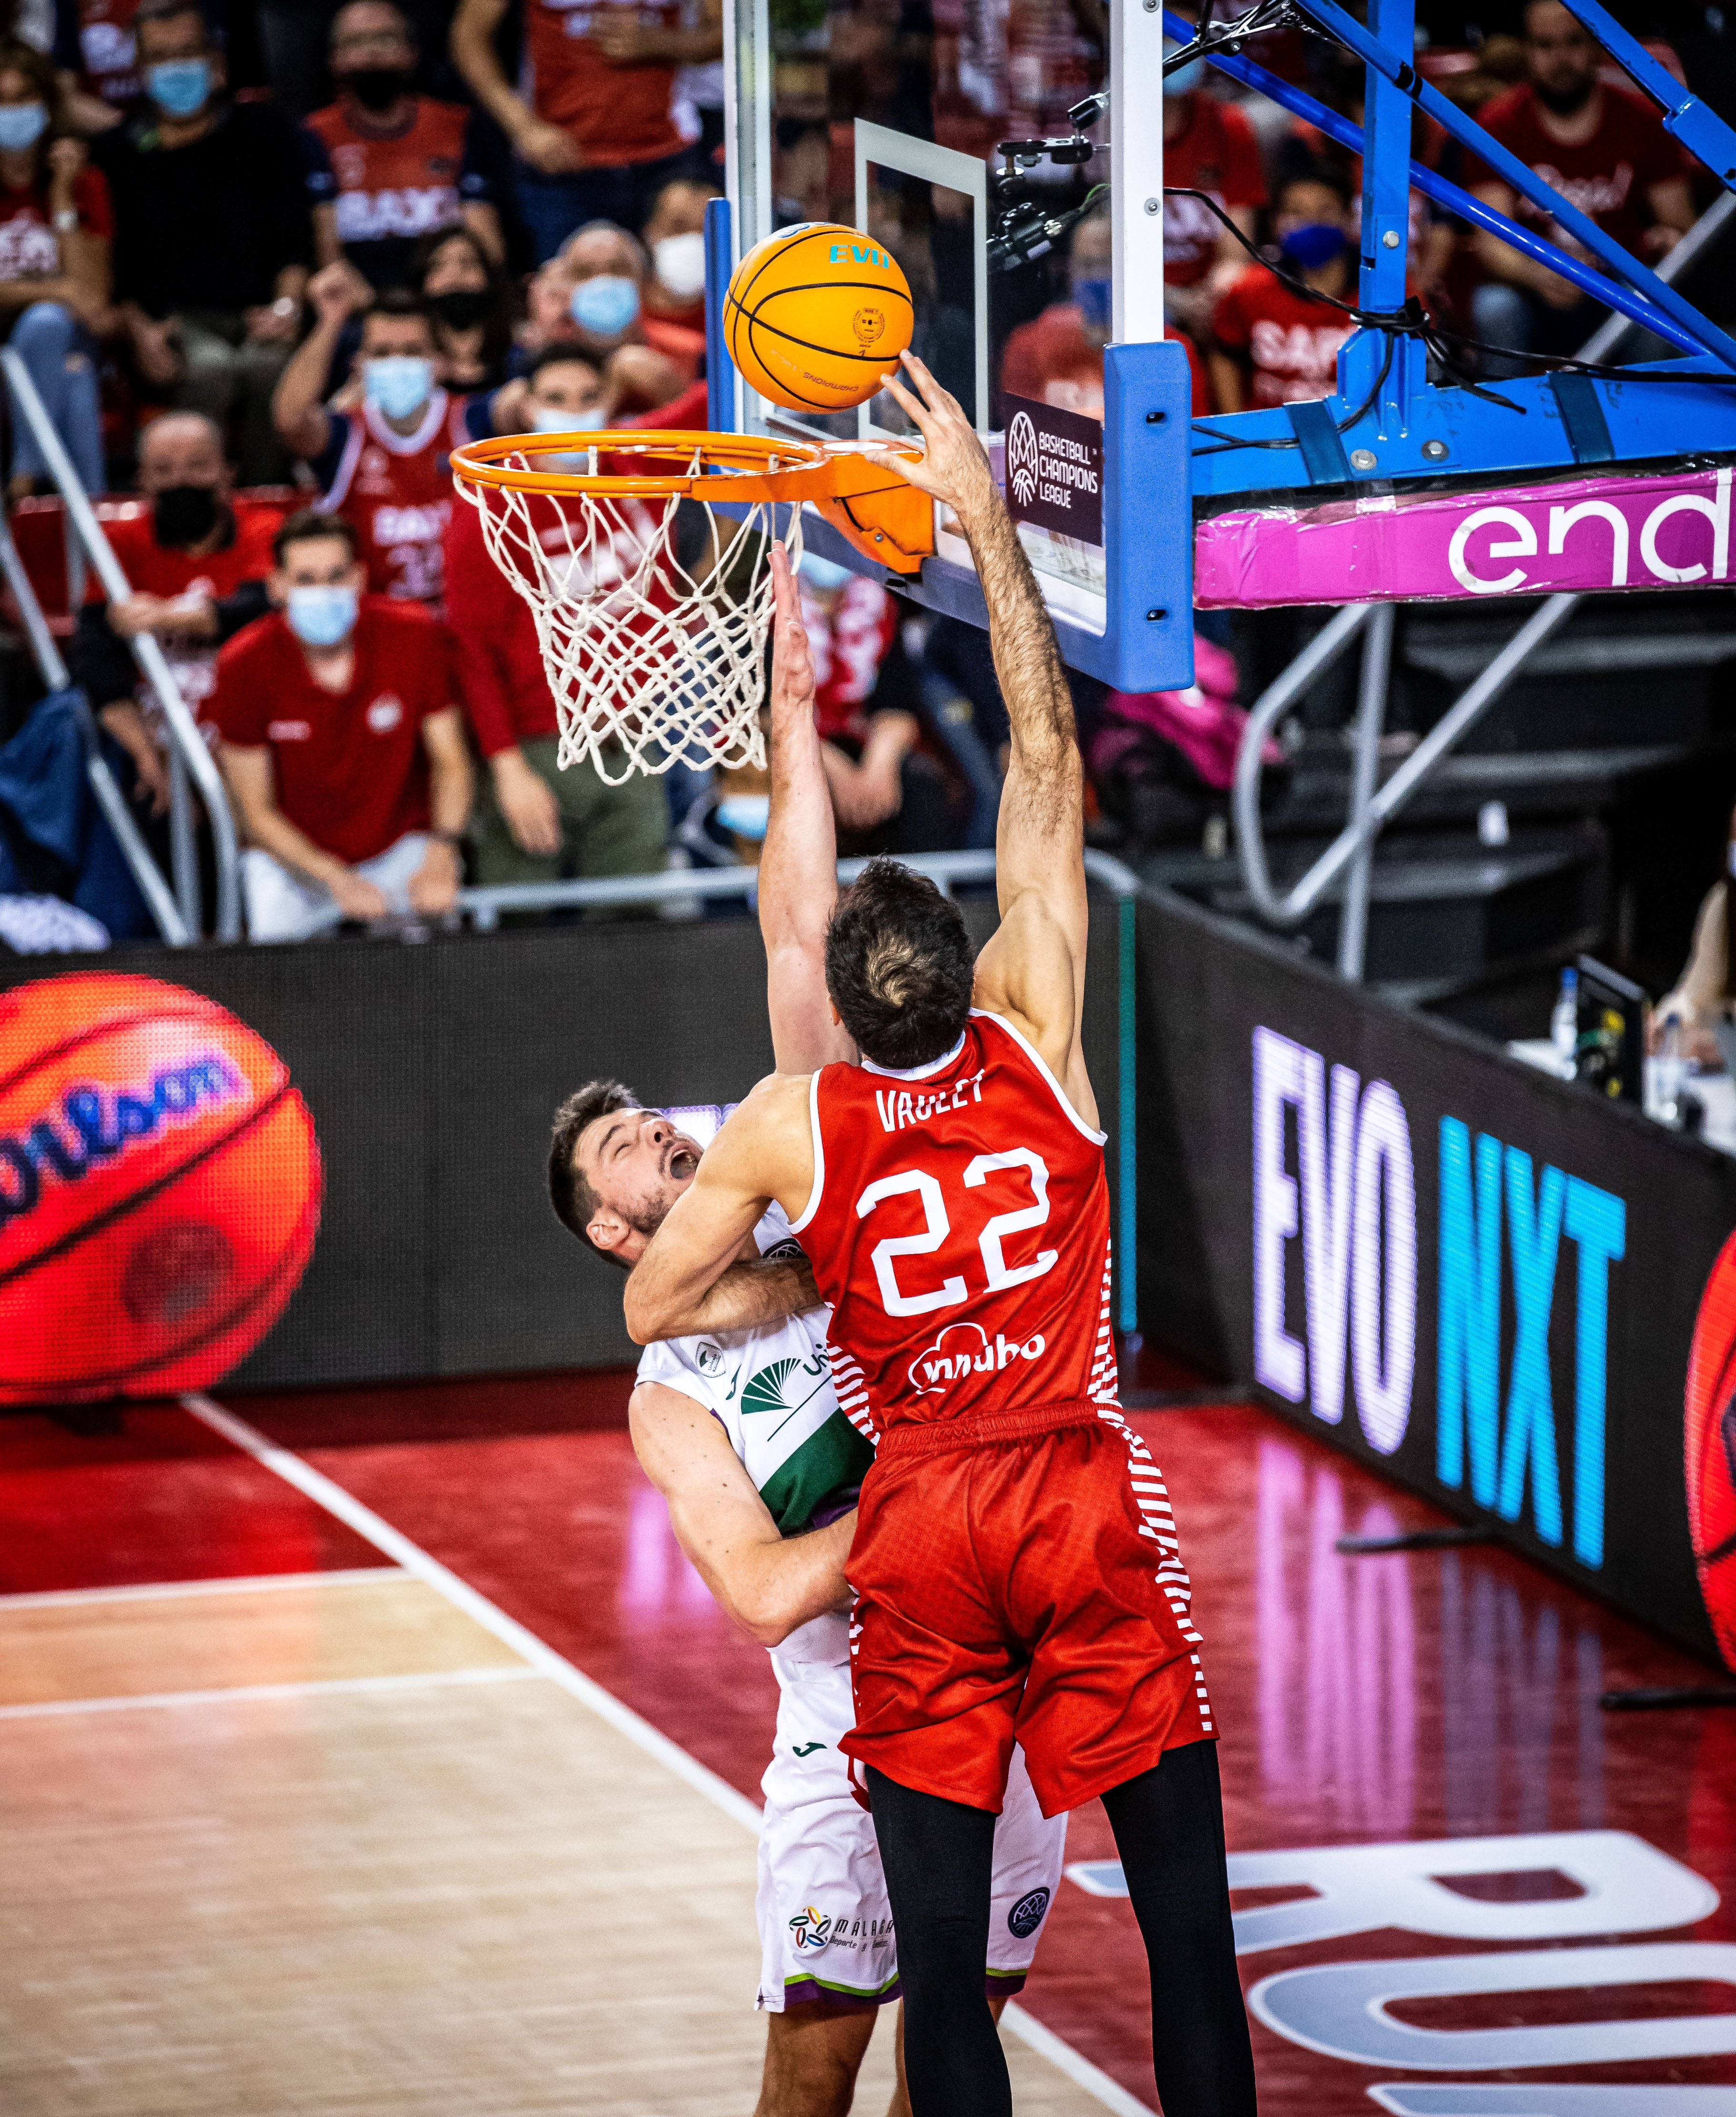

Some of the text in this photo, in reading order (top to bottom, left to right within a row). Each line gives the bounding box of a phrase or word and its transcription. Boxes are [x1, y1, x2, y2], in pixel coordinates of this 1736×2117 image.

[830, 245, 889, 268] EVO
[1039, 431, 1091, 465] BASKETBALL
[1039, 455, 1098, 494] CHAMPIONS
[1039, 481, 1072, 509] LEAGUE
[876, 1068, 986, 1132] VAULET
[856, 1147, 1059, 1316] 22
[1253, 1025, 1417, 1456] EVO
[1436, 1114, 1626, 1571] NXT
